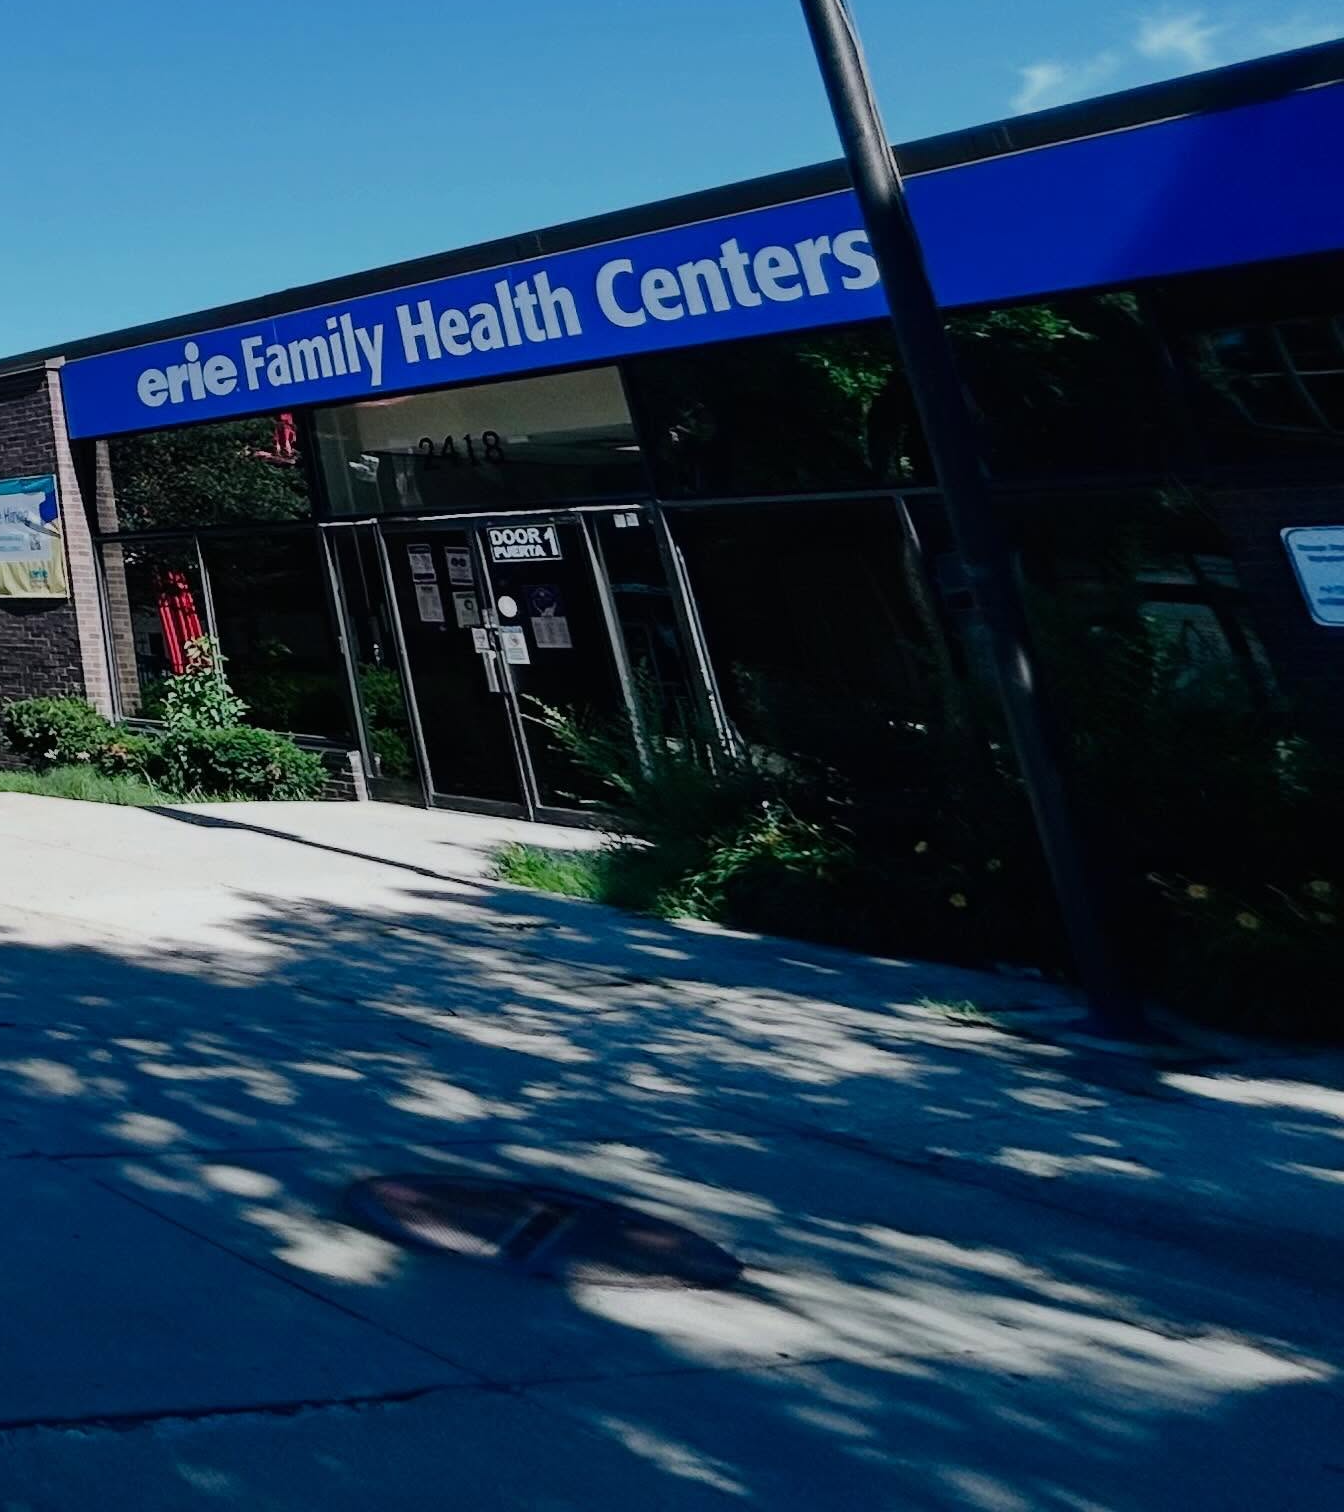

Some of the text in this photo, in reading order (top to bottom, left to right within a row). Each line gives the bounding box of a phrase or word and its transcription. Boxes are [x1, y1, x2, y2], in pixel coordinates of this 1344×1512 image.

[137, 228, 883, 408] erie Family Health Centers
[418, 430, 505, 471] 2418
[490, 526, 559, 556] DOOR 1
[493, 544, 547, 559] PUERTA
